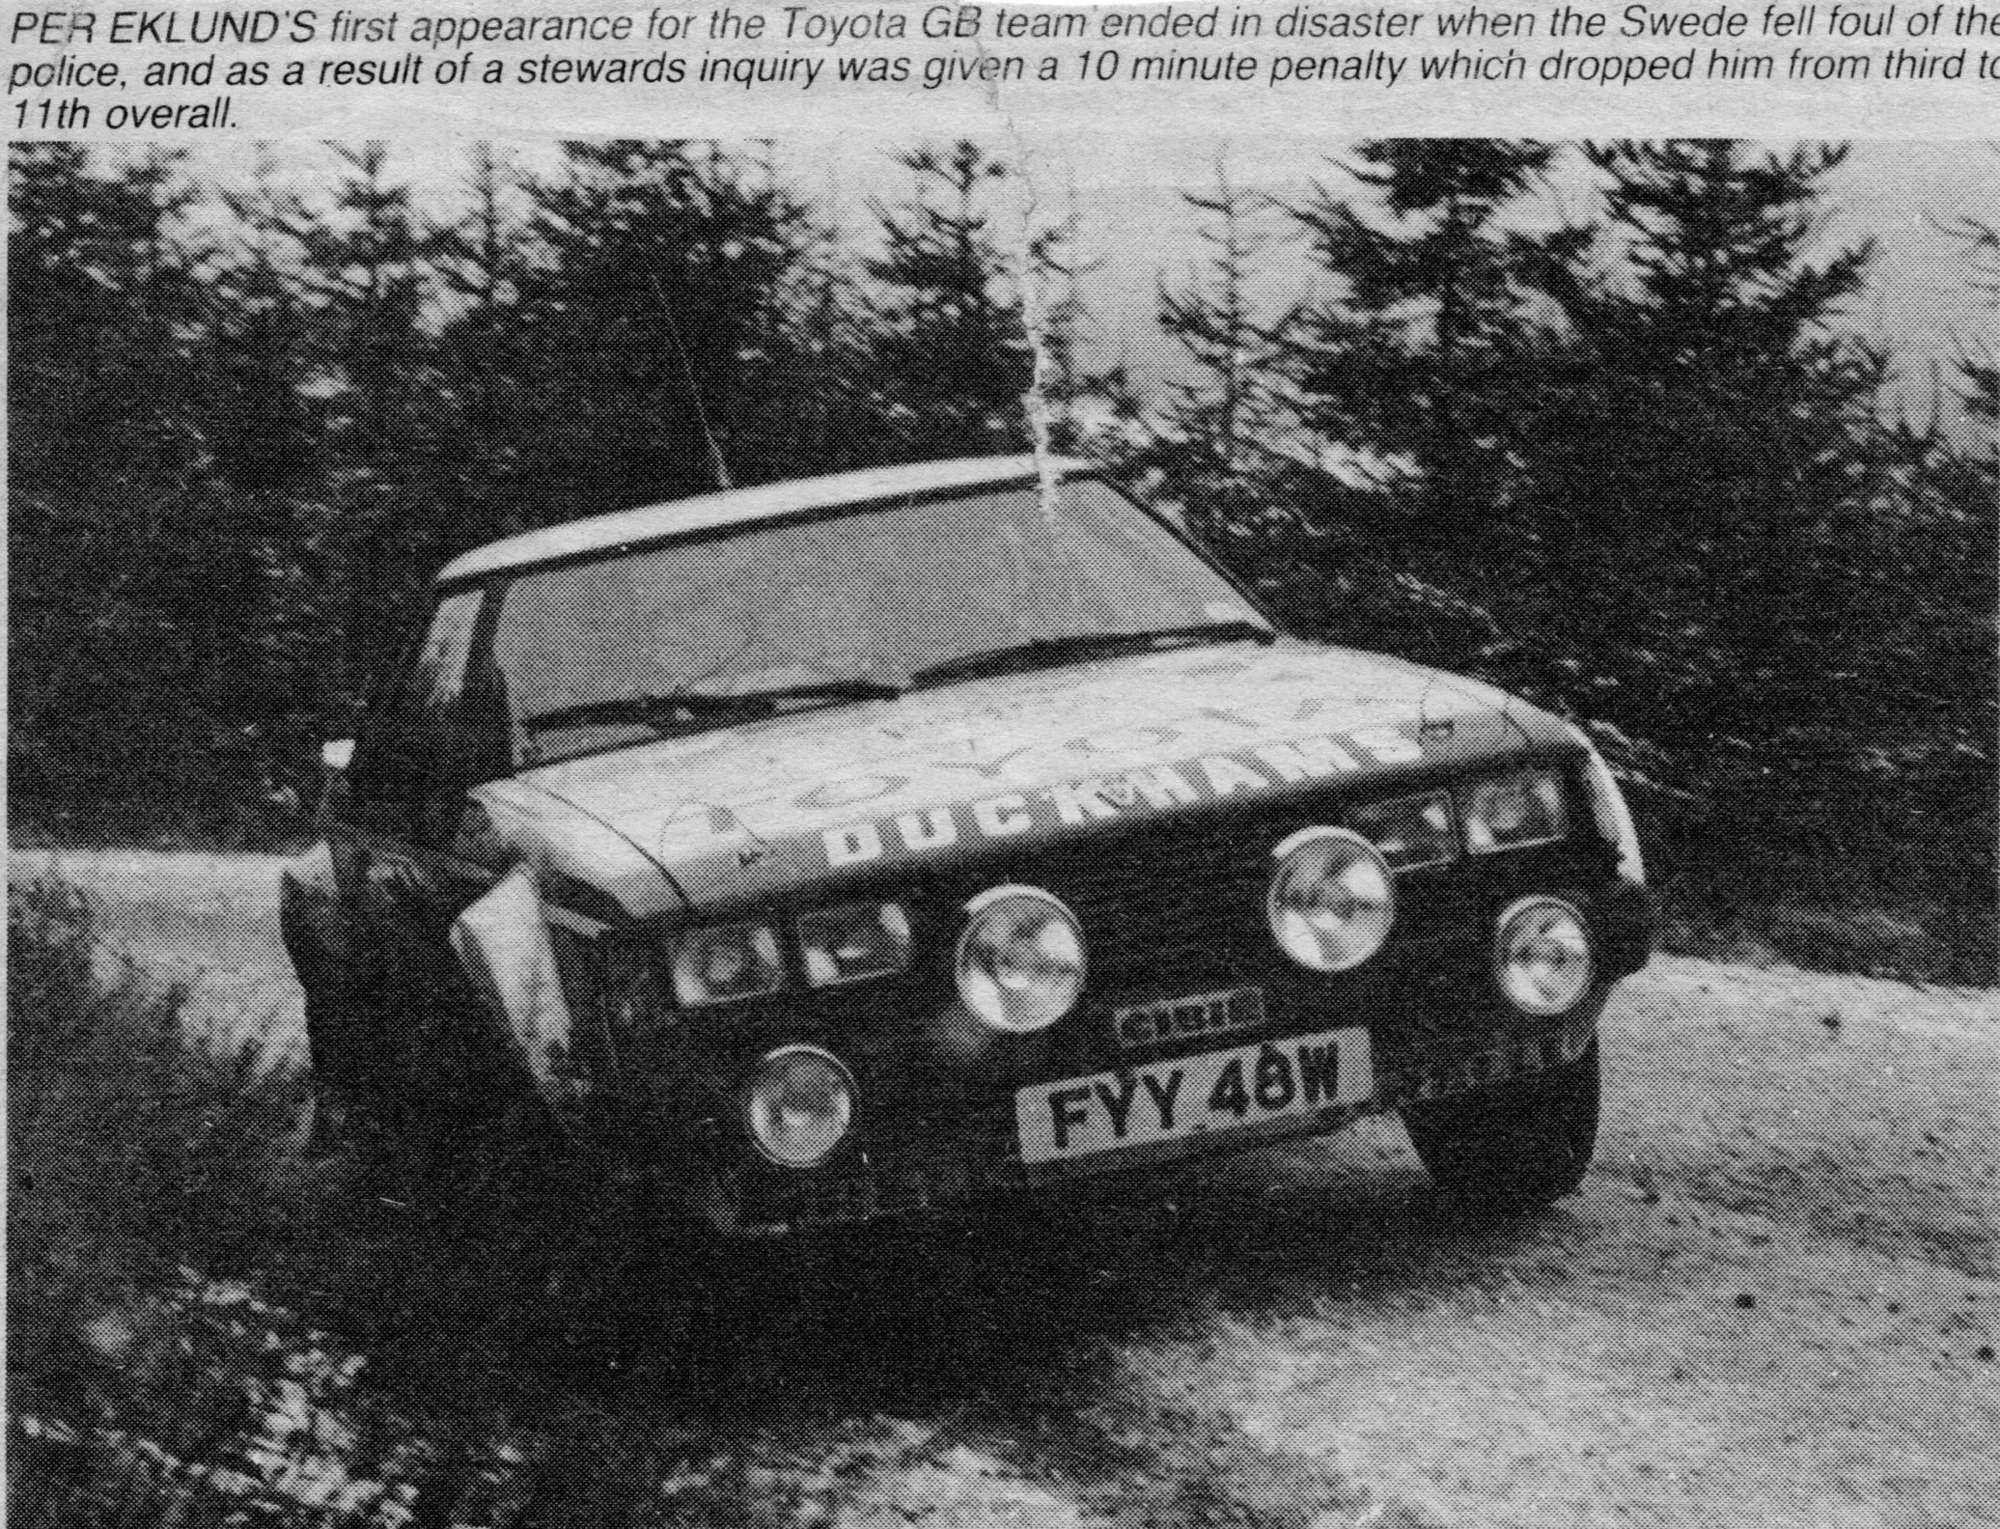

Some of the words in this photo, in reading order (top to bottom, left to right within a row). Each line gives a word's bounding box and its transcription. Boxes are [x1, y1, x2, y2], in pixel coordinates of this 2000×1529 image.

[11, 12, 96, 44] PER
[110, 11, 316, 43] EKLUND'S
[332, 10, 397, 42] first
[411, 16, 632, 48] appearance
[648, 8, 696, 40] for
[710, 8, 765, 39] the
[784, 7, 905, 46] Toyota
[923, 6, 981, 38] GB
[996, 9, 1086, 37] team
[1102, 6, 1218, 37] ended
[1231, 6, 1261, 36] in
[1276, 7, 1423, 37] disaster
[1438, 6, 1534, 37] when
[1550, 5, 1606, 37] the
[1621, 5, 1747, 37] Swede
[1763, 5, 1815, 36] fell
[1829, 5, 1895, 36] foul
[1907, 4, 1945, 36] of
[8, 55, 125, 94] police,
[144, 54, 214, 86] and
[226, 62, 269, 85] as
[283, 61, 304, 85] a
[320, 53, 423, 85] result
[435, 52, 473, 85] of
[483, 60, 503, 84] a
[518, 51, 686, 84] stewards
[700, 51, 824, 89] inquiry
[839, 58, 910, 81] was
[923, 49, 1024, 89] given
[1038, 57, 1057, 80] a
[1080, 50, 1119, 80] 10
[1132, 50, 1257, 80] minute
[1270, 50, 1407, 88] penalty
[1422, 49, 1526, 80] which
[1540, 49, 1695, 87] dropped
[1708, 48, 1773, 79] him
[1790, 48, 1870, 79] from
[1884, 48, 1966, 79] third
[16, 99, 90, 129] 11th
[106, 97, 237, 129] overall.
[822, 728, 1423, 868] DUCKHAMS
[1047, 1069, 1184, 1149] FYY
